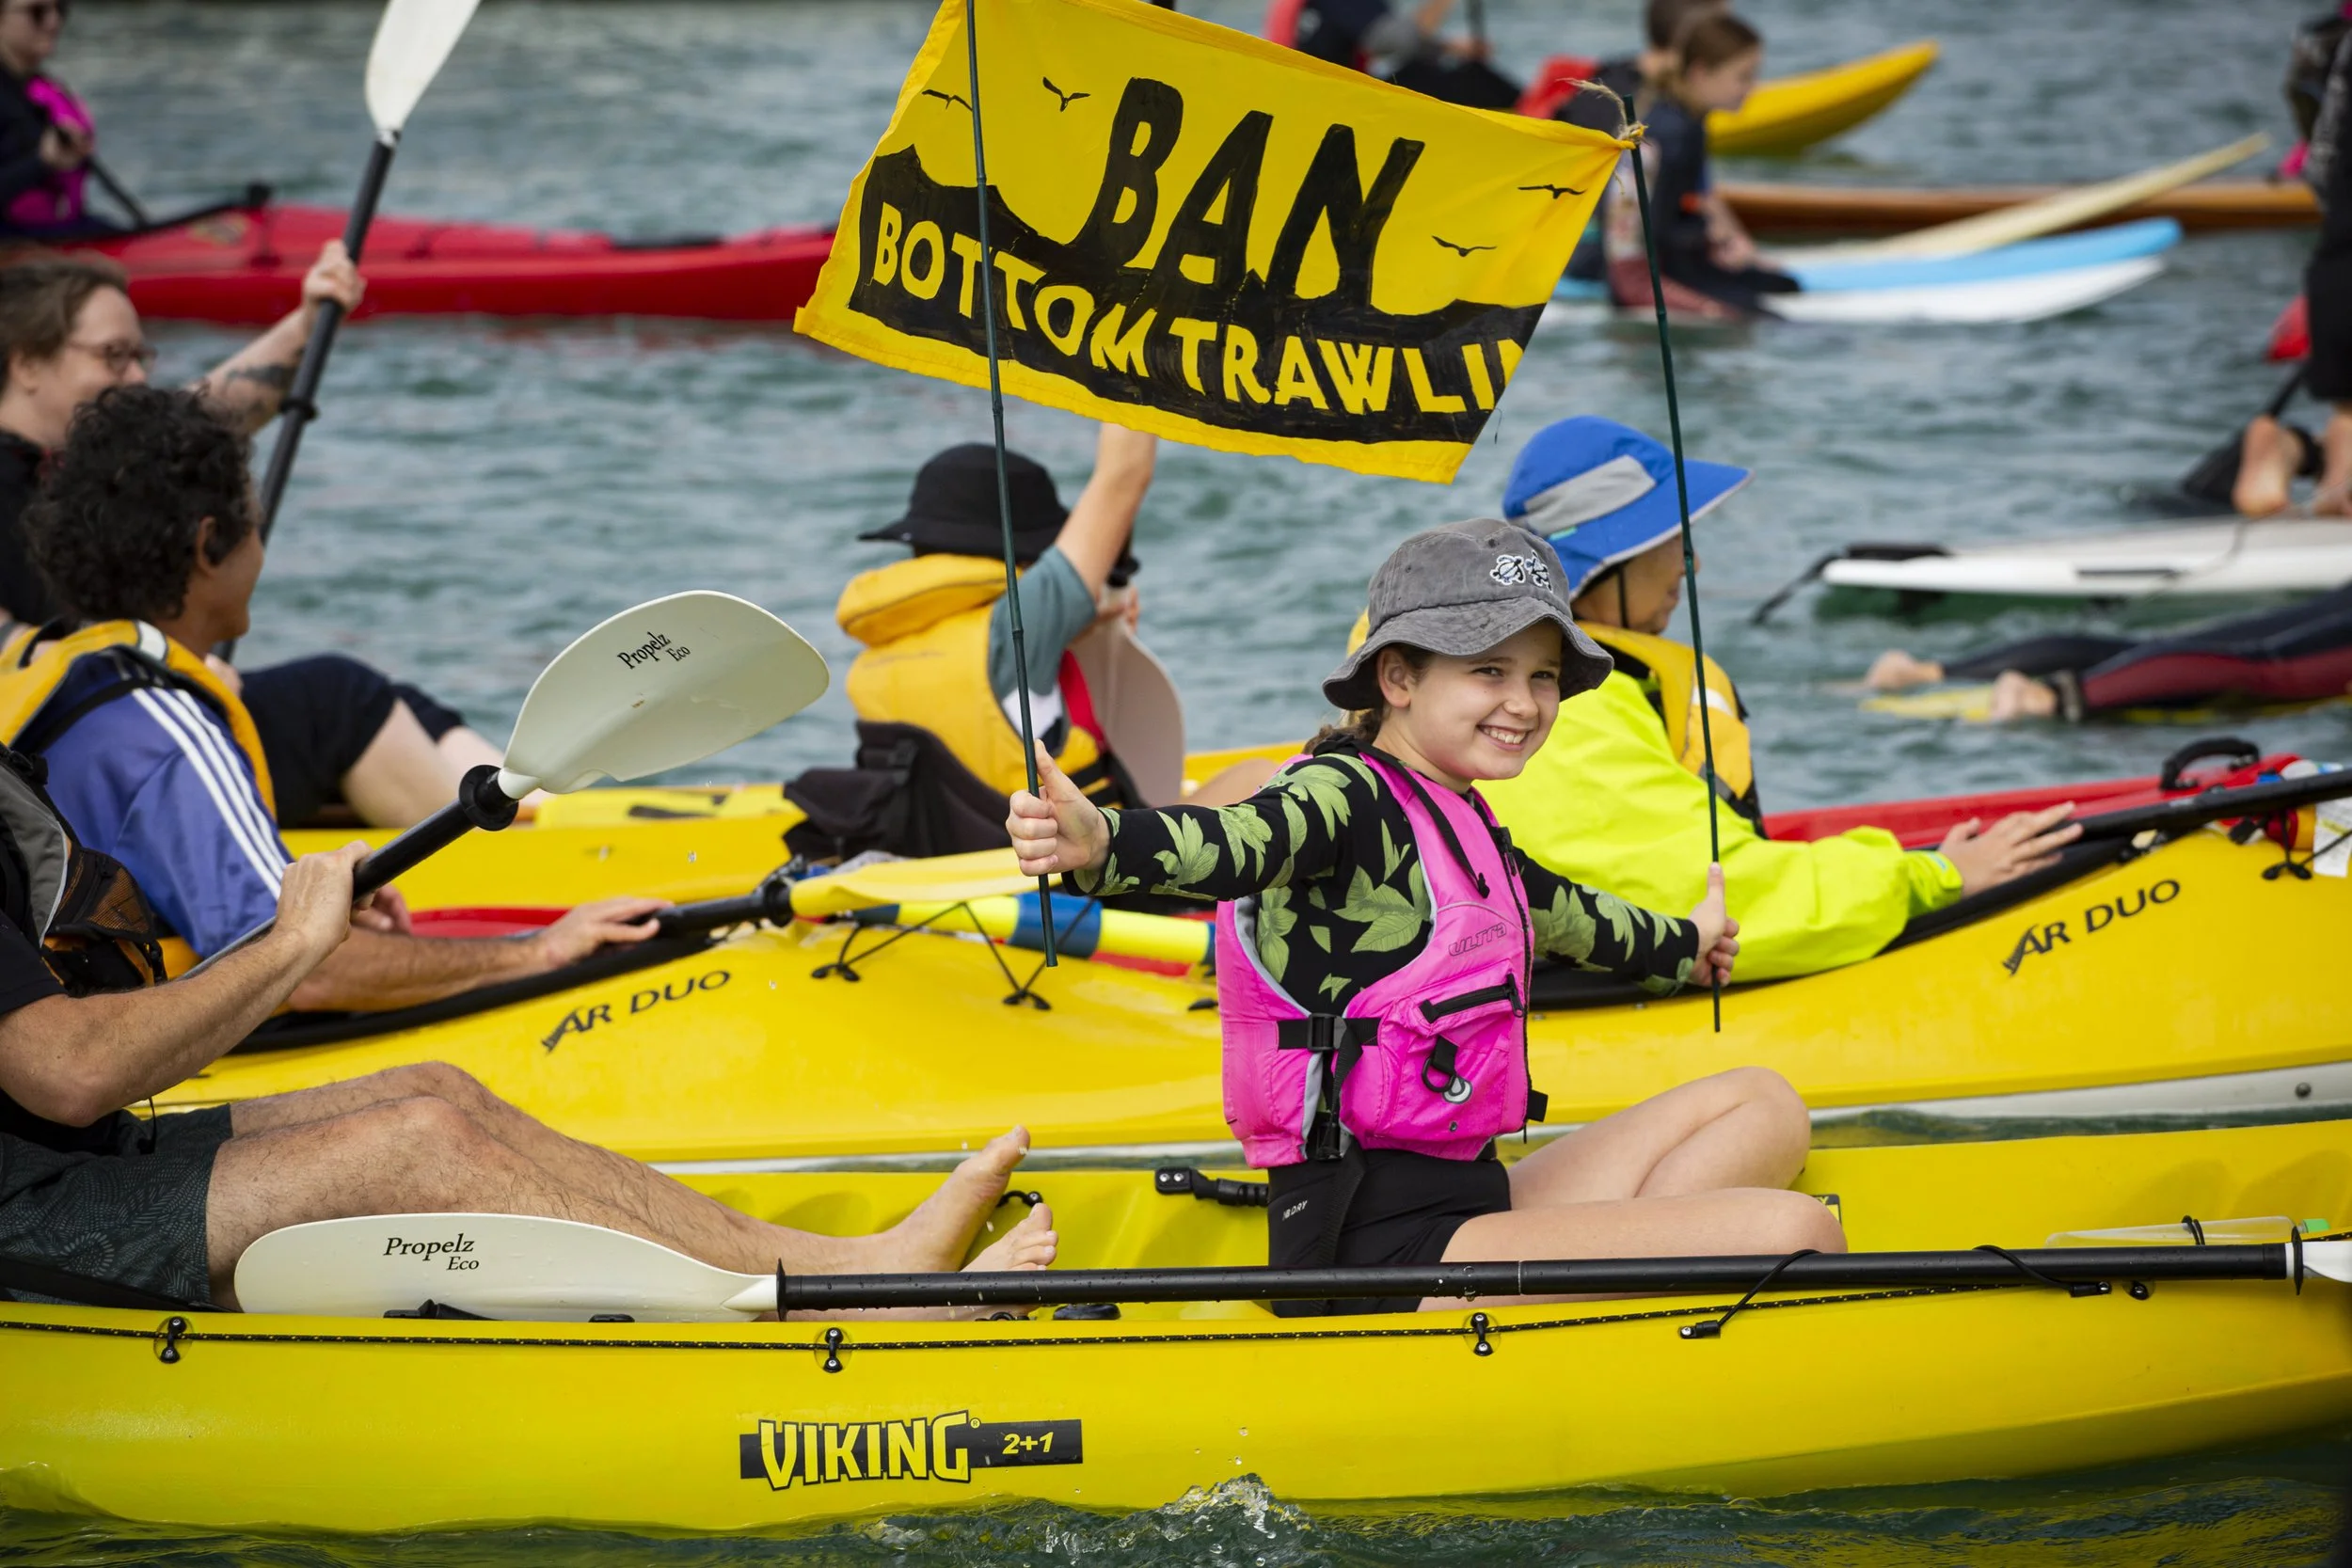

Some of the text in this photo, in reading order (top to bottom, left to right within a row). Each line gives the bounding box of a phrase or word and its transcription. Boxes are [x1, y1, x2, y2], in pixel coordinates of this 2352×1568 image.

[1075, 77, 1425, 309] BAN
[872, 200, 1158, 378] BOTTOM
[617, 631, 672, 670] Propelz
[665, 646, 691, 662] Eco
[2084, 879, 2181, 934] DUO
[1448, 922, 1507, 957] ULTRA
[629, 970, 731, 1015] DUO
[383, 1232, 475, 1261] Propelz
[446, 1255, 480, 1271] Eco
[1002, 1432, 1054, 1455] 2+1
